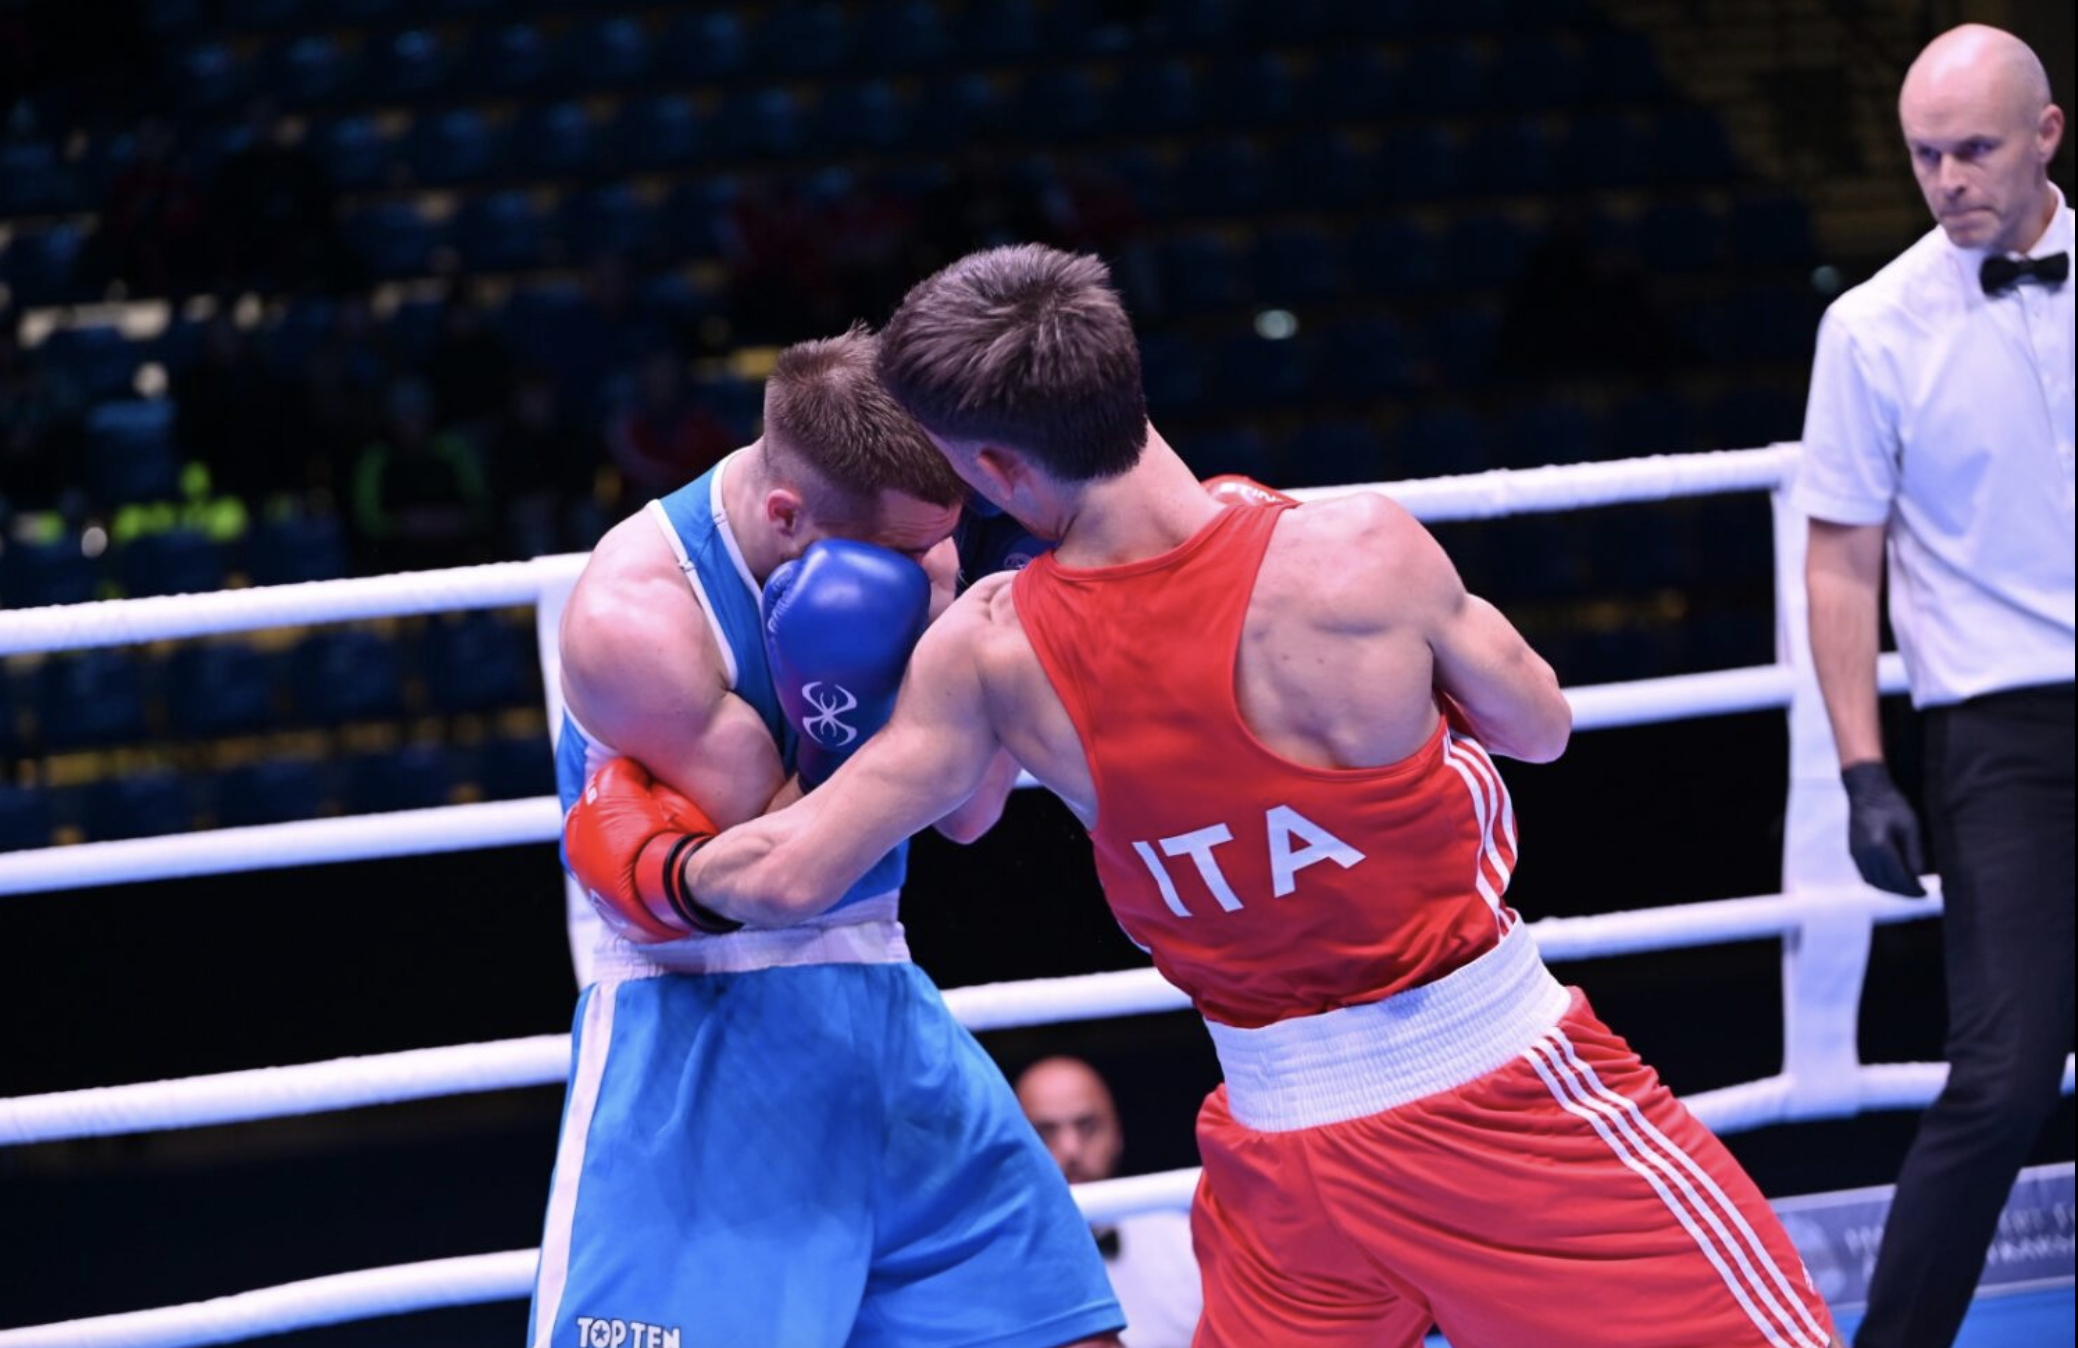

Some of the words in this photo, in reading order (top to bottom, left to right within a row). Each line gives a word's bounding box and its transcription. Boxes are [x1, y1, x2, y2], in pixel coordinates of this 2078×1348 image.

[1131, 804, 1367, 917] ITA
[577, 1317, 626, 1348] TOP
[630, 1322, 681, 1348] TEN
